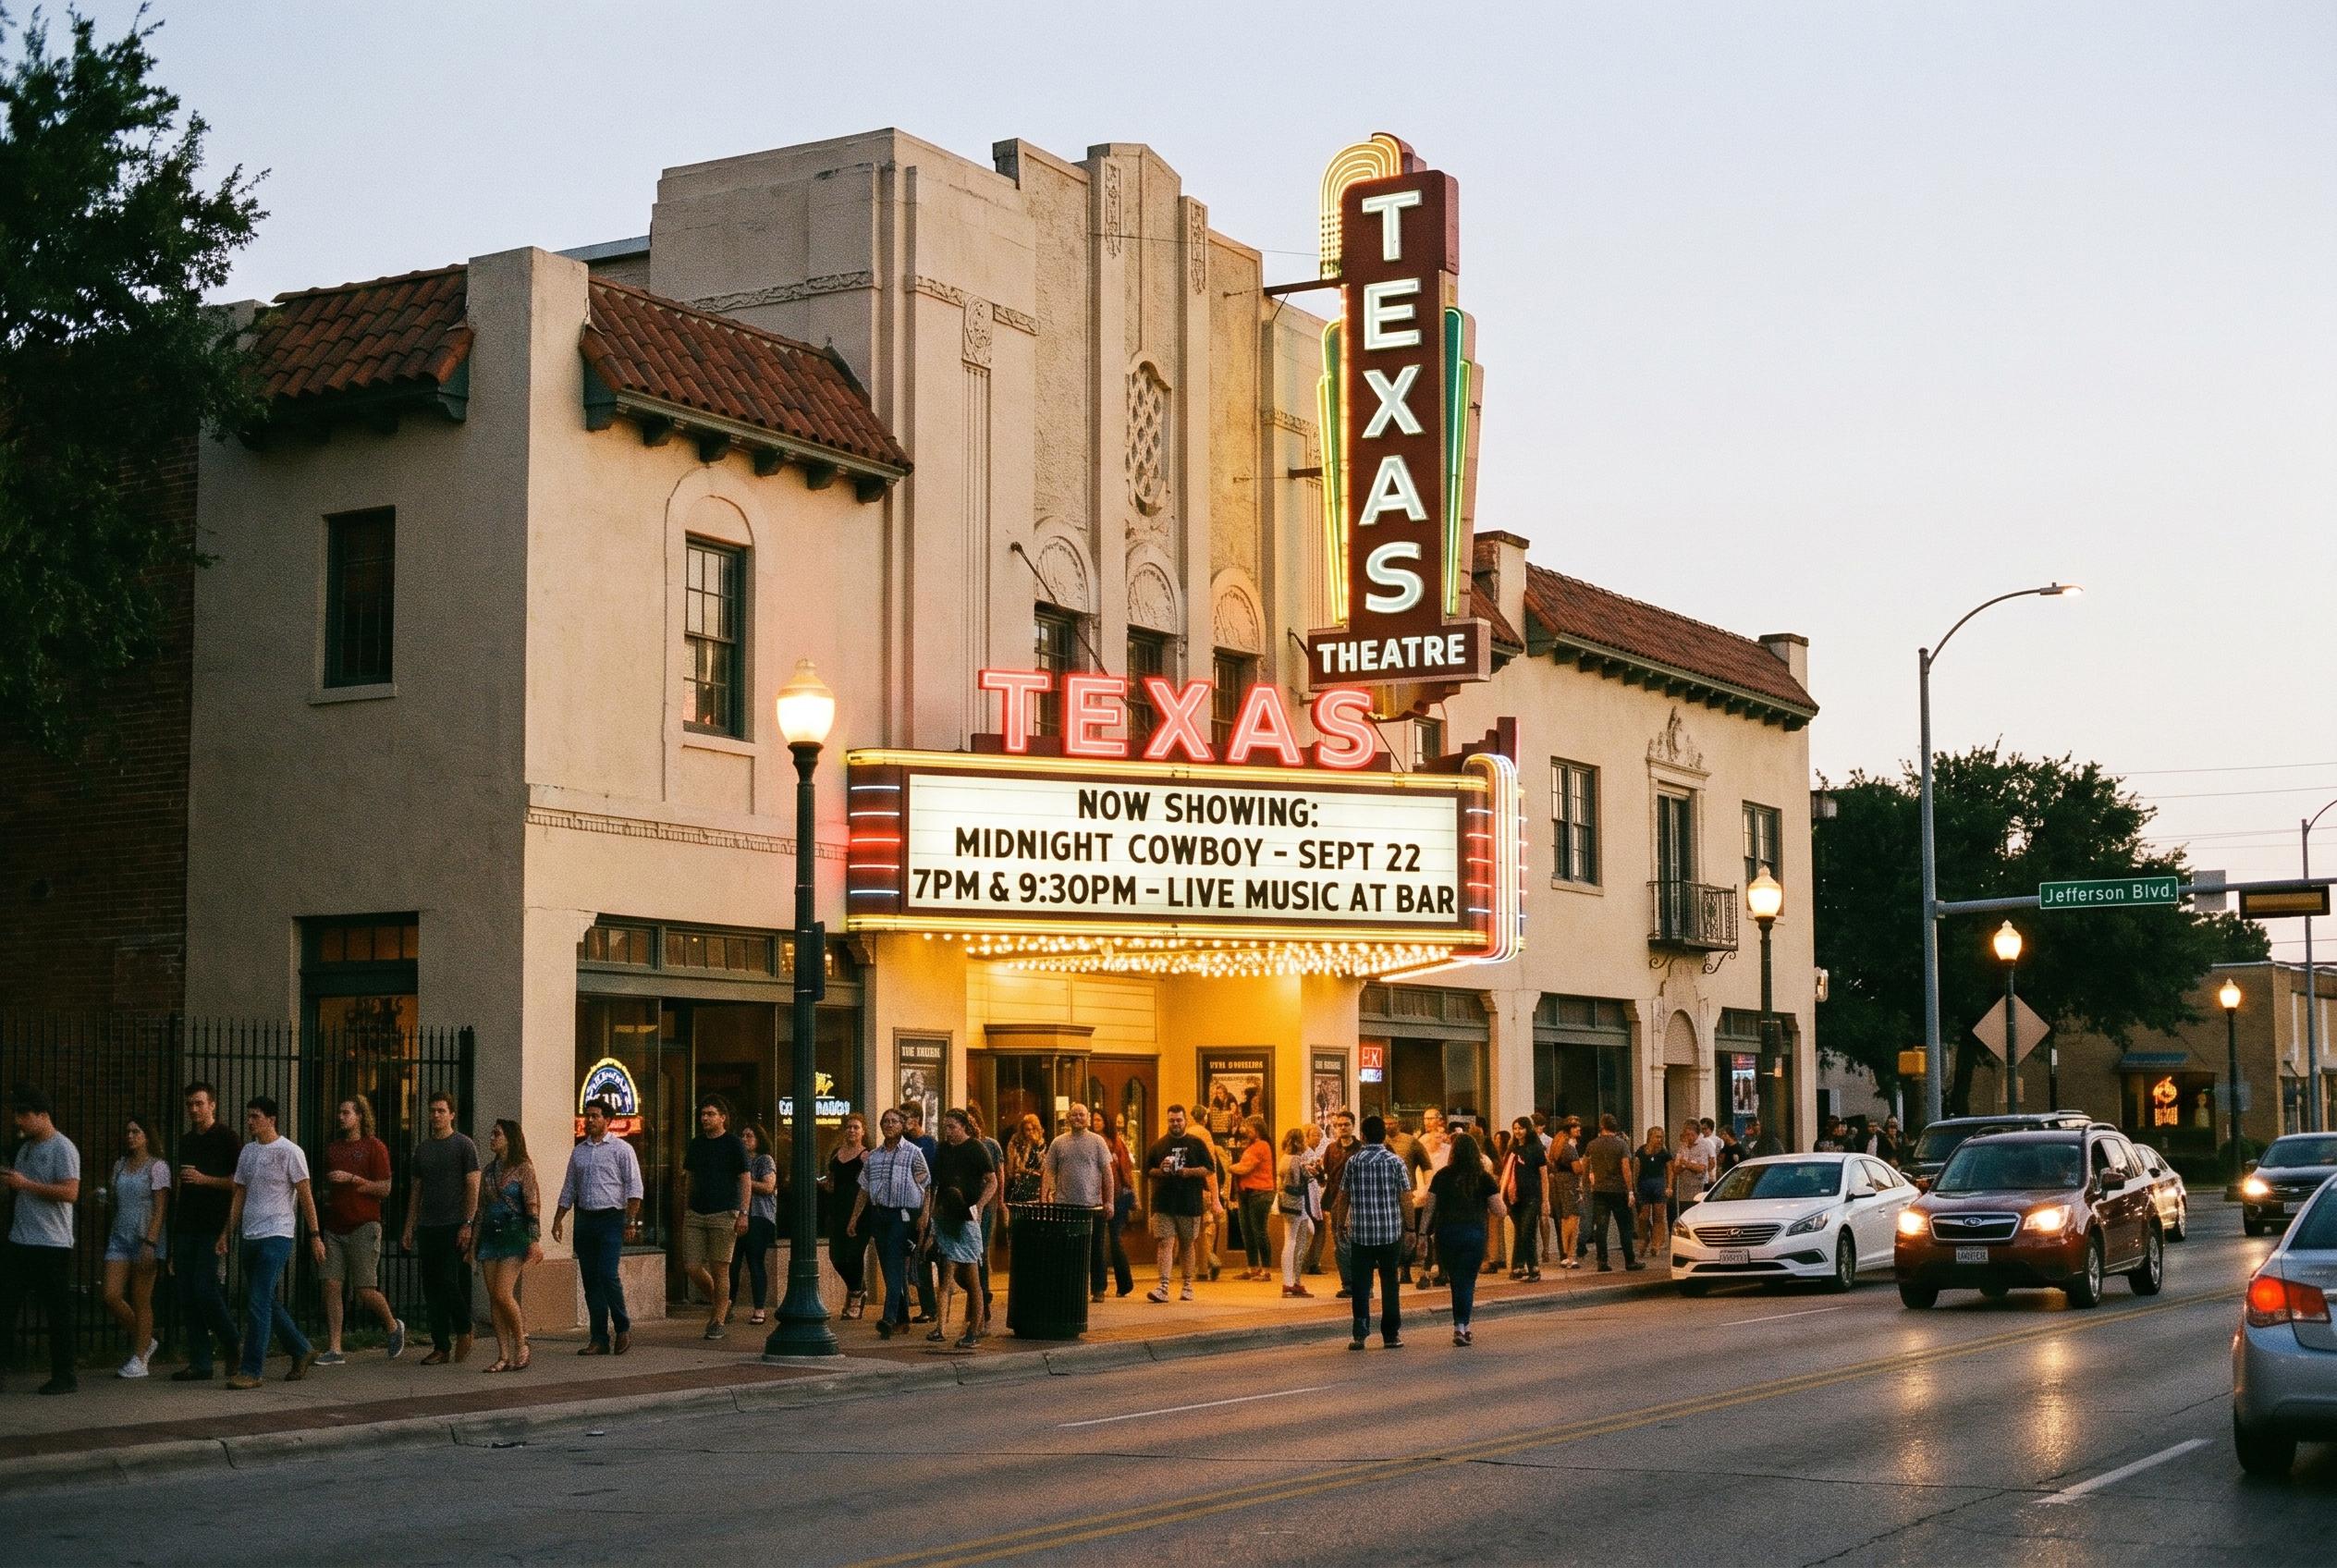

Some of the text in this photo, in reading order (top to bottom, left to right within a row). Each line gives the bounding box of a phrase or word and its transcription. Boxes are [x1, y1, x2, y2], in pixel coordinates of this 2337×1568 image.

[1359, 189, 1430, 614] TEXAS
[1316, 633, 1466, 674] THEATRE
[979, 669, 1377, 769] TEXAS
[1078, 789, 1319, 829] NOW SHOWING:
[955, 827, 1114, 864] MIDNIGHT
[1127, 834, 1265, 868] COWBOY
[1298, 839, 1375, 871] SEPT
[1386, 843, 1422, 873] 22
[912, 868, 980, 901] 7PM
[989, 871, 1010, 902] &
[1019, 873, 1137, 905] 9:30PM
[1168, 876, 1235, 910] LIVE
[1245, 879, 1340, 913] MUSIC
[1349, 883, 1387, 913] AT
[1396, 884, 1456, 914] BAR
[2044, 883, 2175, 903] Jefferson Blvd.
